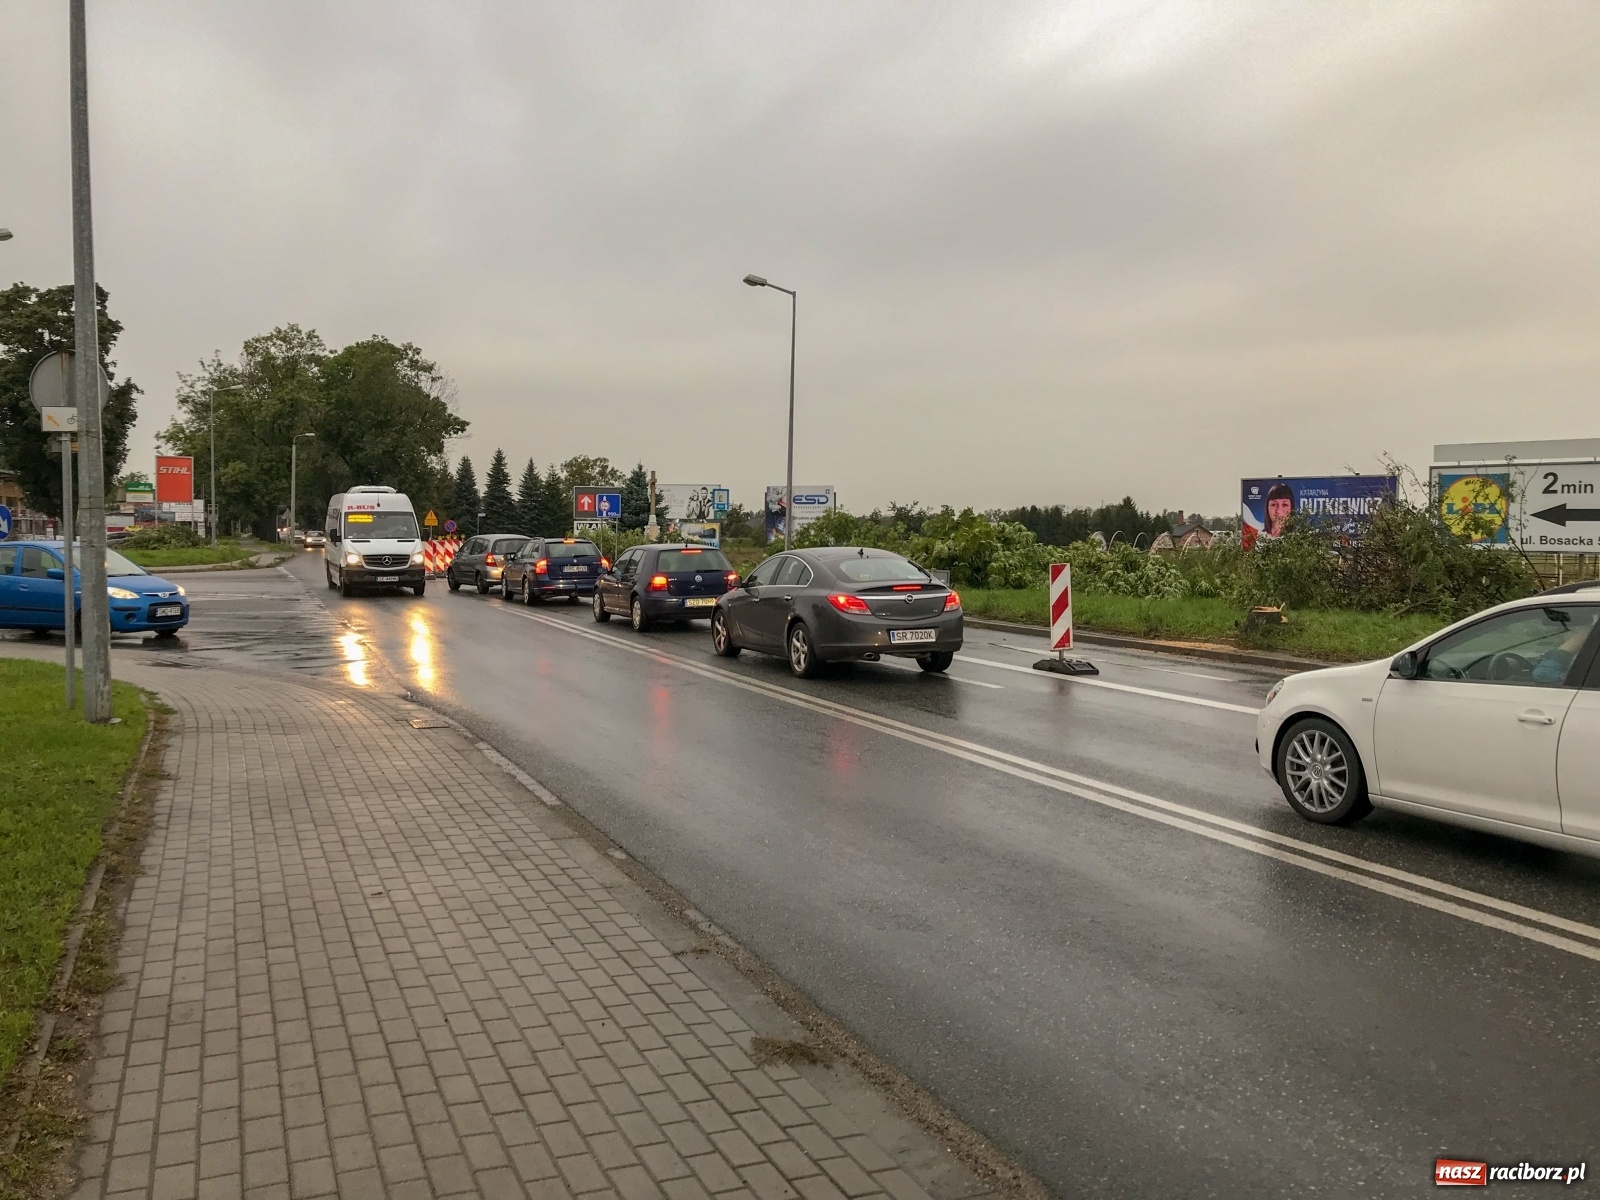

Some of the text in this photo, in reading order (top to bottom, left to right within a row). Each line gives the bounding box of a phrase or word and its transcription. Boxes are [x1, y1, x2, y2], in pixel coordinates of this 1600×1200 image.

[158, 466, 191, 475] STIHL
[1541, 472, 1594, 495] 2 min
[793, 494, 829, 505] ESD
[1521, 535, 1535, 545] ul.
[1539, 535, 1594, 546] Bosacka
[896, 630, 934, 641] SR 7020K
